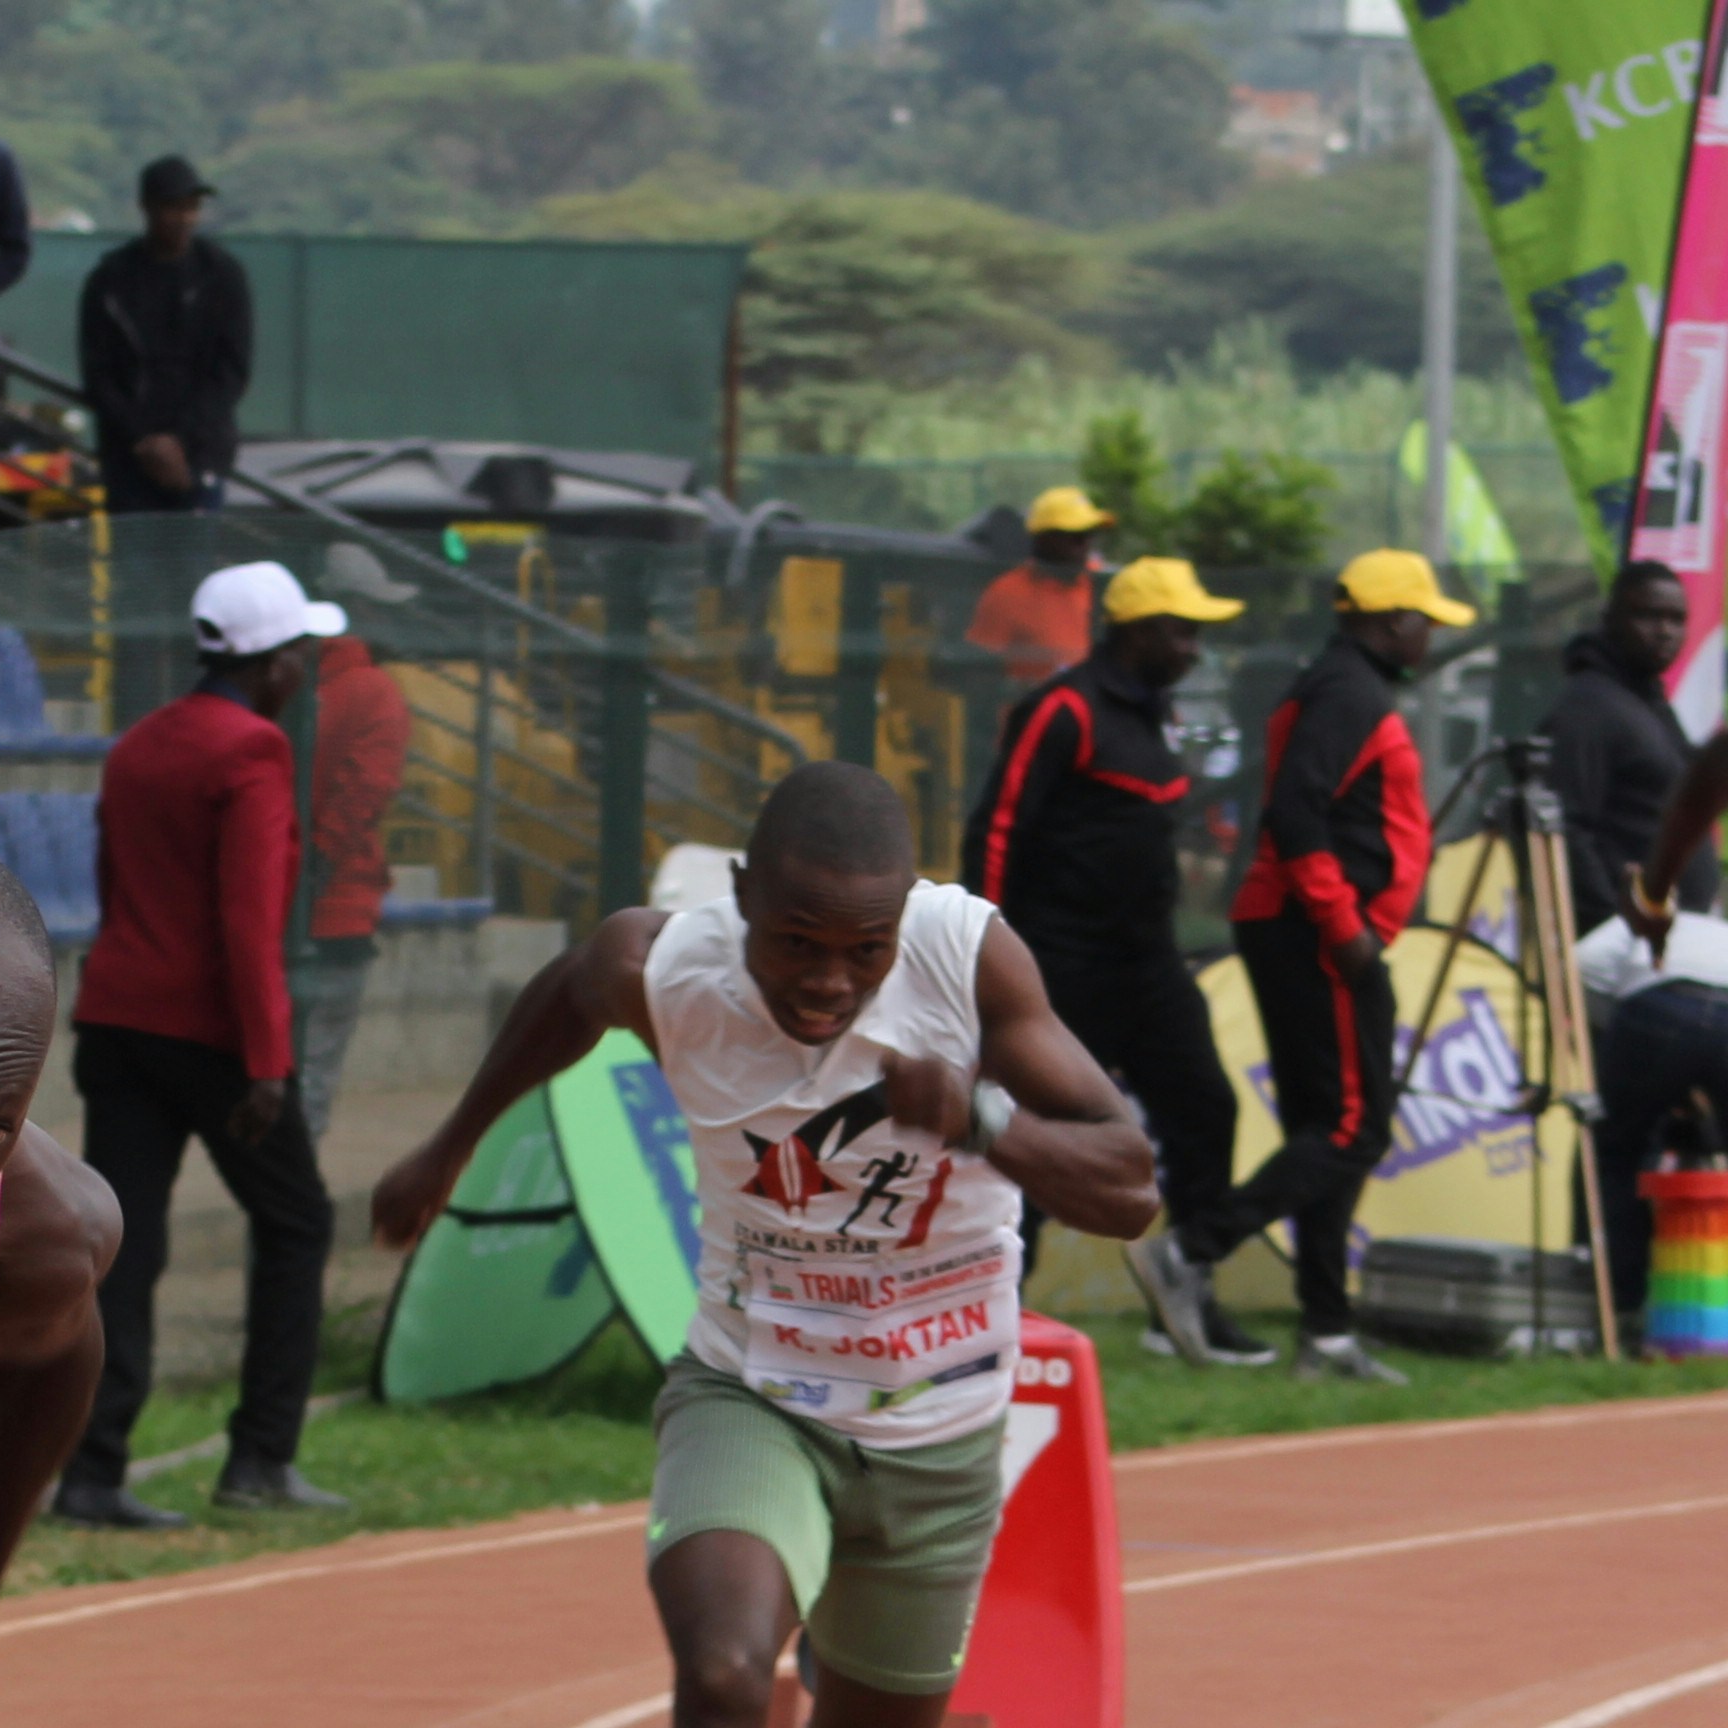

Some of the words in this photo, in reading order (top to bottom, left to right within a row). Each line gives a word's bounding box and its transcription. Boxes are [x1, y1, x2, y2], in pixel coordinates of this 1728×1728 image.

[825, 1238, 880, 1253] STAR
[797, 1272, 898, 1310] TRIALS
[774, 1322, 816, 1355] K.
[831, 1300, 991, 1362] JOKTAN
